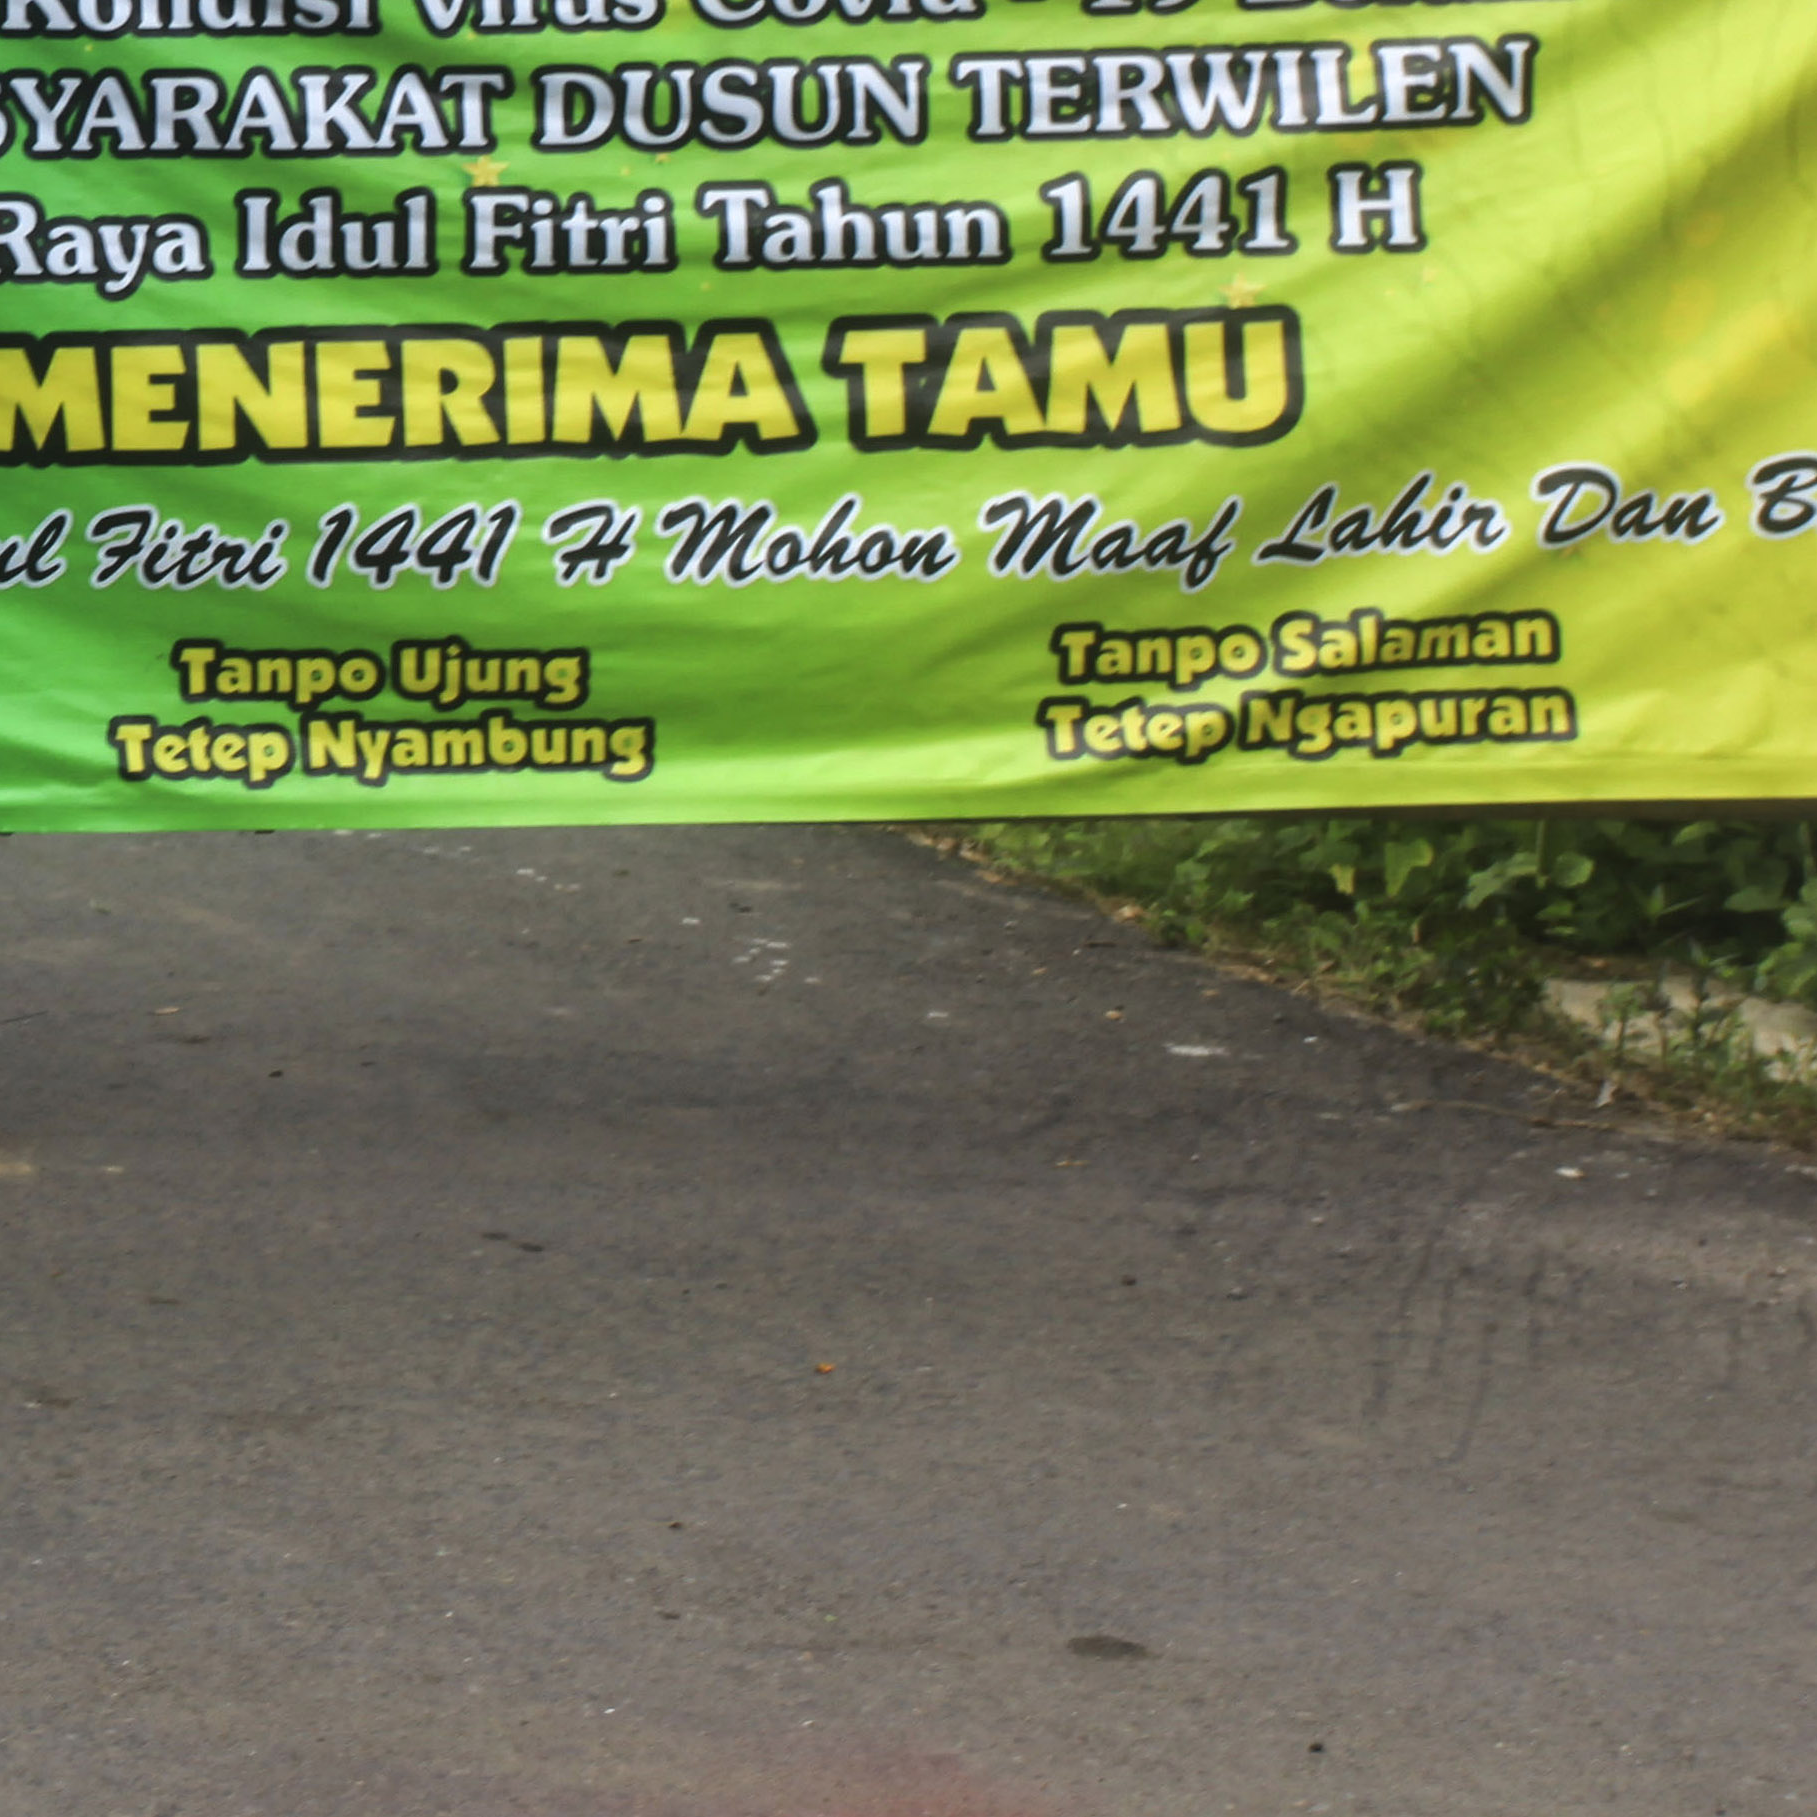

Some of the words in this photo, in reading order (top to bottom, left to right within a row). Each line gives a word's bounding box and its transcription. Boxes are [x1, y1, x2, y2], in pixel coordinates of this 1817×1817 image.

[534, 55, 926, 148] DUSUN
[956, 35, 1536, 137] TERWILEN
[235, 188, 434, 273] Idul
[466, 188, 674, 276] Fitri
[704, 179, 1011, 270] Tahun
[1040, 170, 1298, 259] 1441
[1331, 164, 1424, 255] H
[827, 306, 1301, 451] TAMU
[87, 505, 291, 589] Fitri
[307, 499, 521, 589] 1441
[542, 498, 642, 586] H
[655, 493, 961, 585] Mohon
[978, 490, 1243, 593] Maaf
[1253, 469, 1513, 563] Lahir
[1533, 461, 1728, 551] Dan
[173, 638, 384, 709] Tanpo
[390, 636, 590, 710] Ujung
[1051, 623, 1267, 690] Tanpo
[1270, 607, 1561, 677] Salaman
[110, 715, 295, 789] Tetep
[302, 709, 655, 787] Nyambung
[1036, 696, 1234, 765] Tetep
[1239, 688, 1578, 758] Ngapuran
